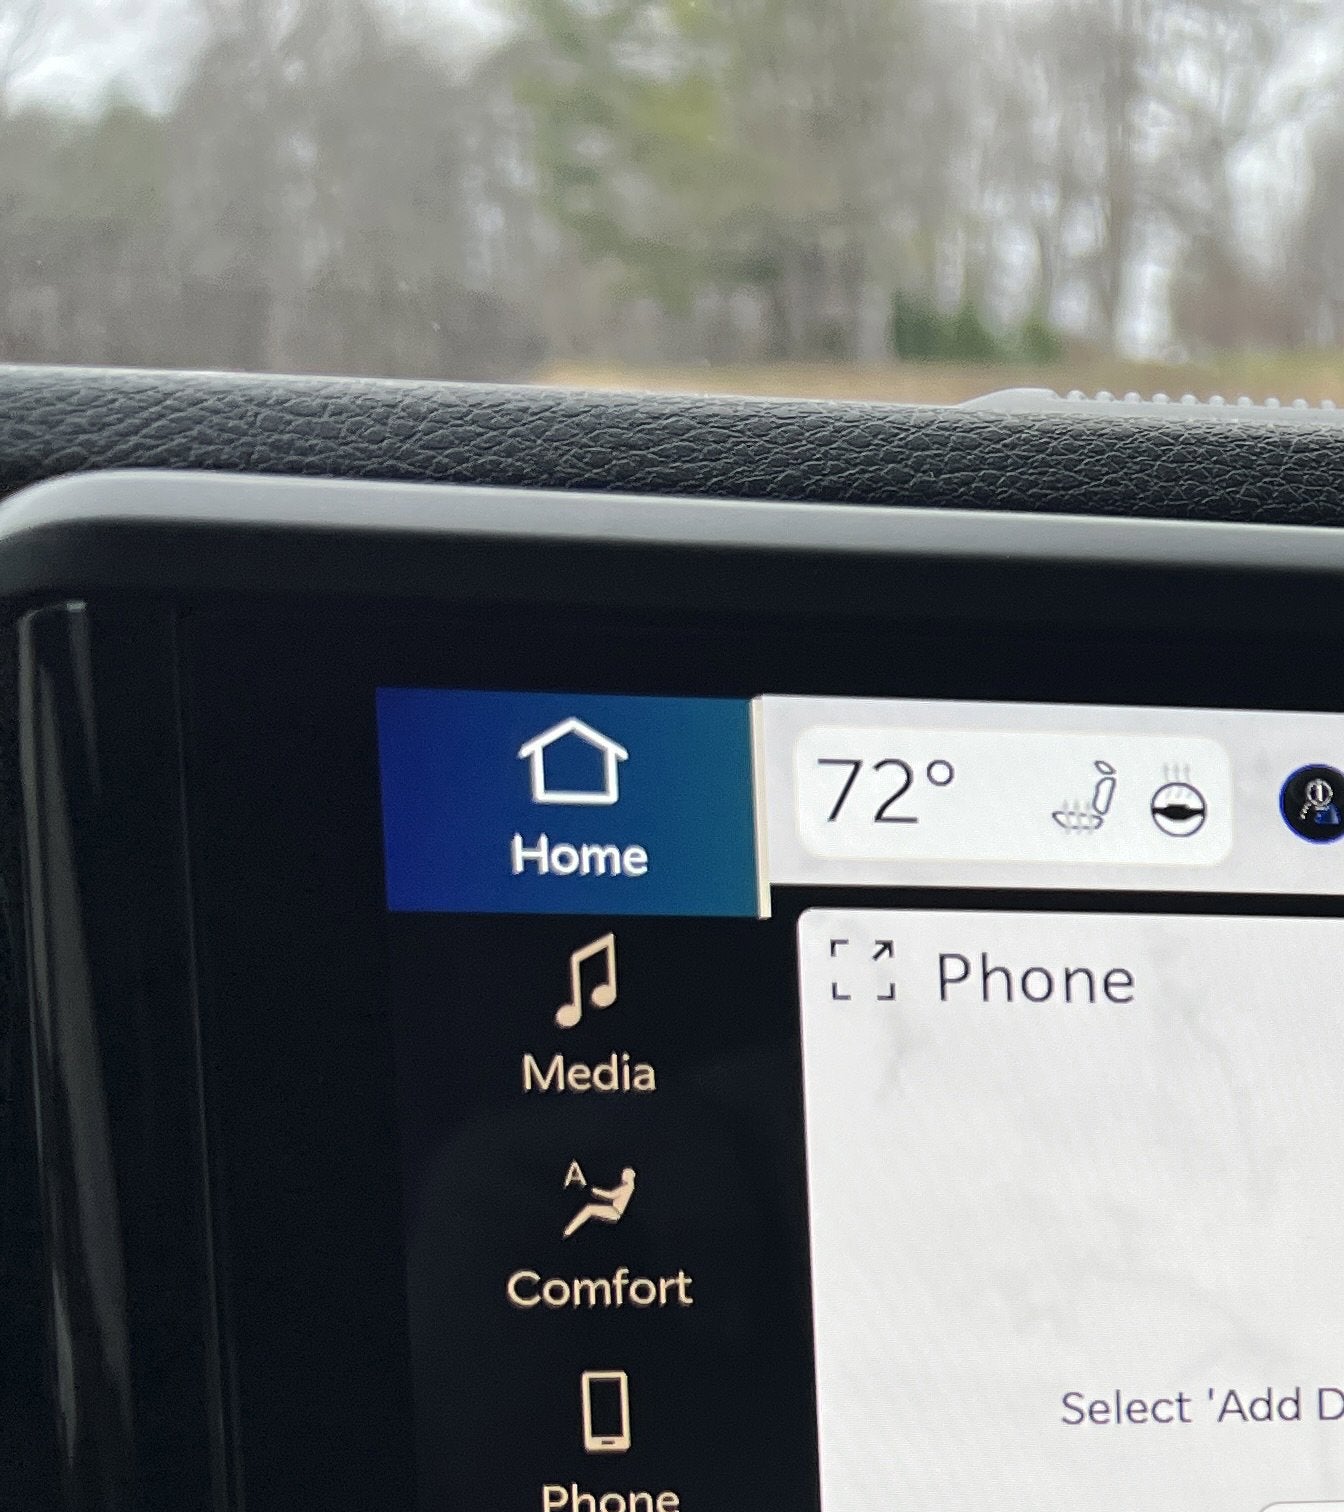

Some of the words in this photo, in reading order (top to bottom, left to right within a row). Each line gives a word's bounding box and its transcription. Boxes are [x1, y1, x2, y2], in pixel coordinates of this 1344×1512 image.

[818, 758, 955, 824] 72°
[512, 832, 648, 877] Home
[938, 952, 1135, 1004] Phone
[523, 1053, 656, 1092] Media
[507, 1268, 693, 1307] Comfort
[1061, 1388, 1192, 1426] Select
[1208, 1386, 1302, 1423] 'Add
